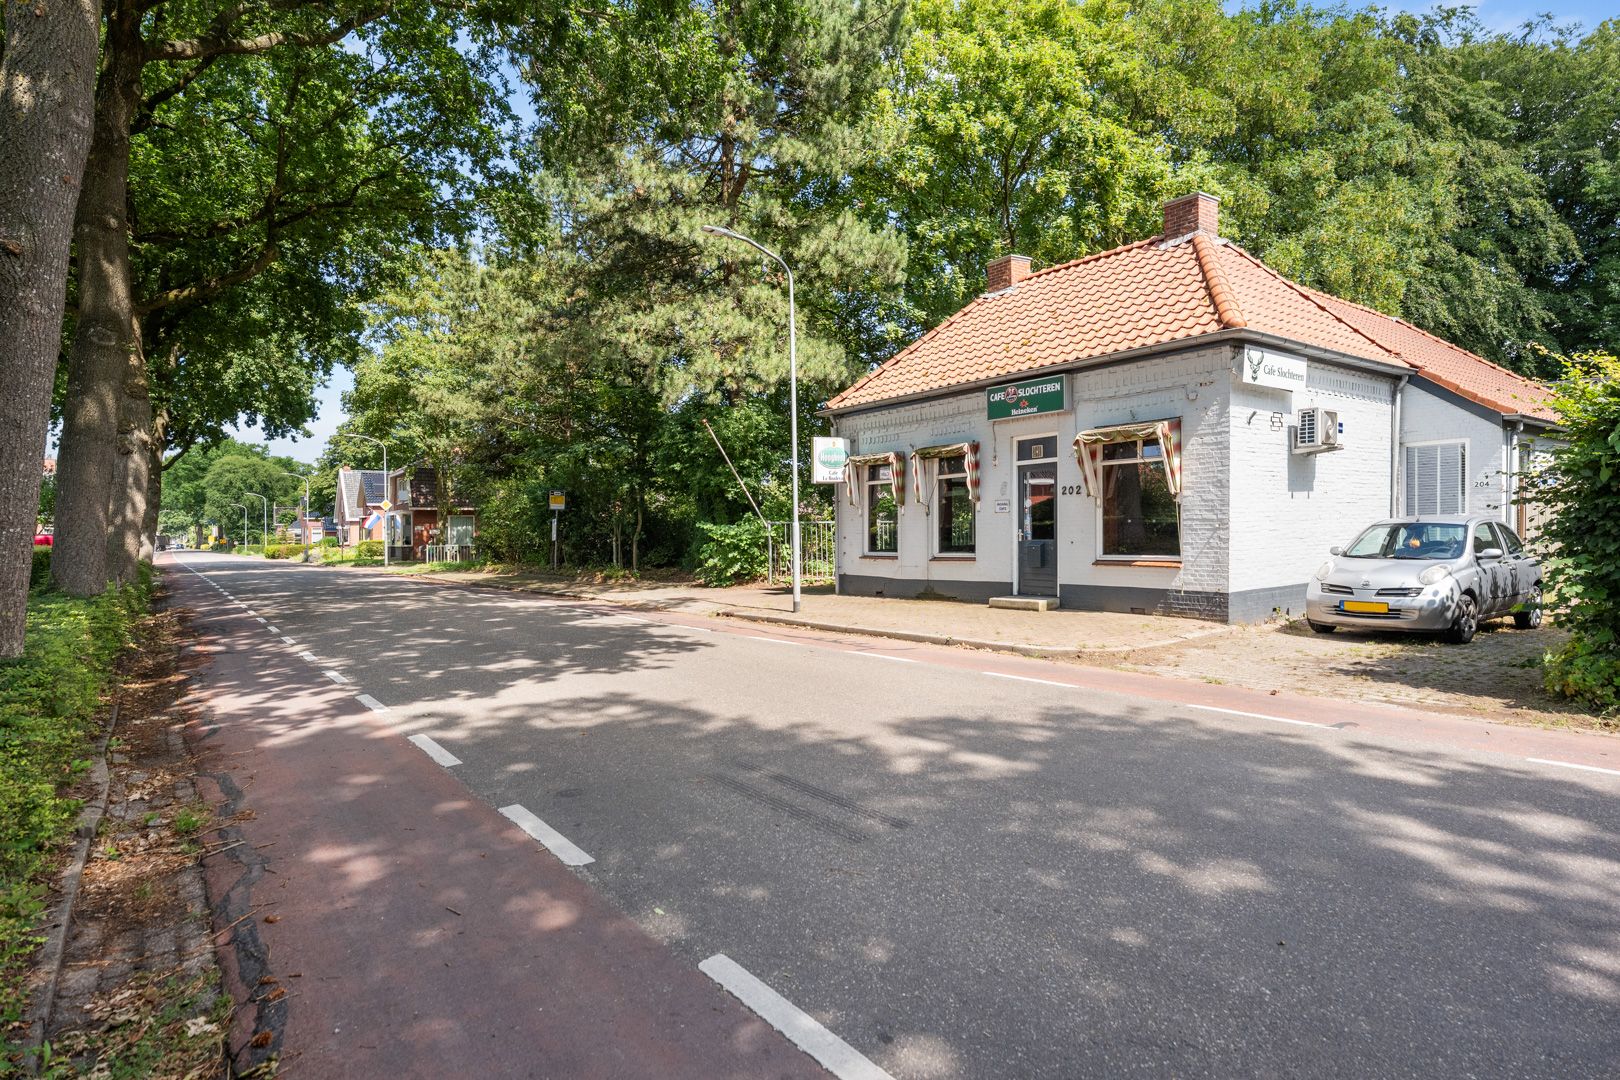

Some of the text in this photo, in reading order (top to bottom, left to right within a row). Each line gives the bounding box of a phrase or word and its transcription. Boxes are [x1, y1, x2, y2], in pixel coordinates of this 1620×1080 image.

[1263, 364, 1305, 381] Cafe Slochteren
[990, 382, 1061, 402] CAFE SLOCHTEREN
[1011, 407, 1038, 416] Heineken
[1061, 485, 1081, 495] 202
